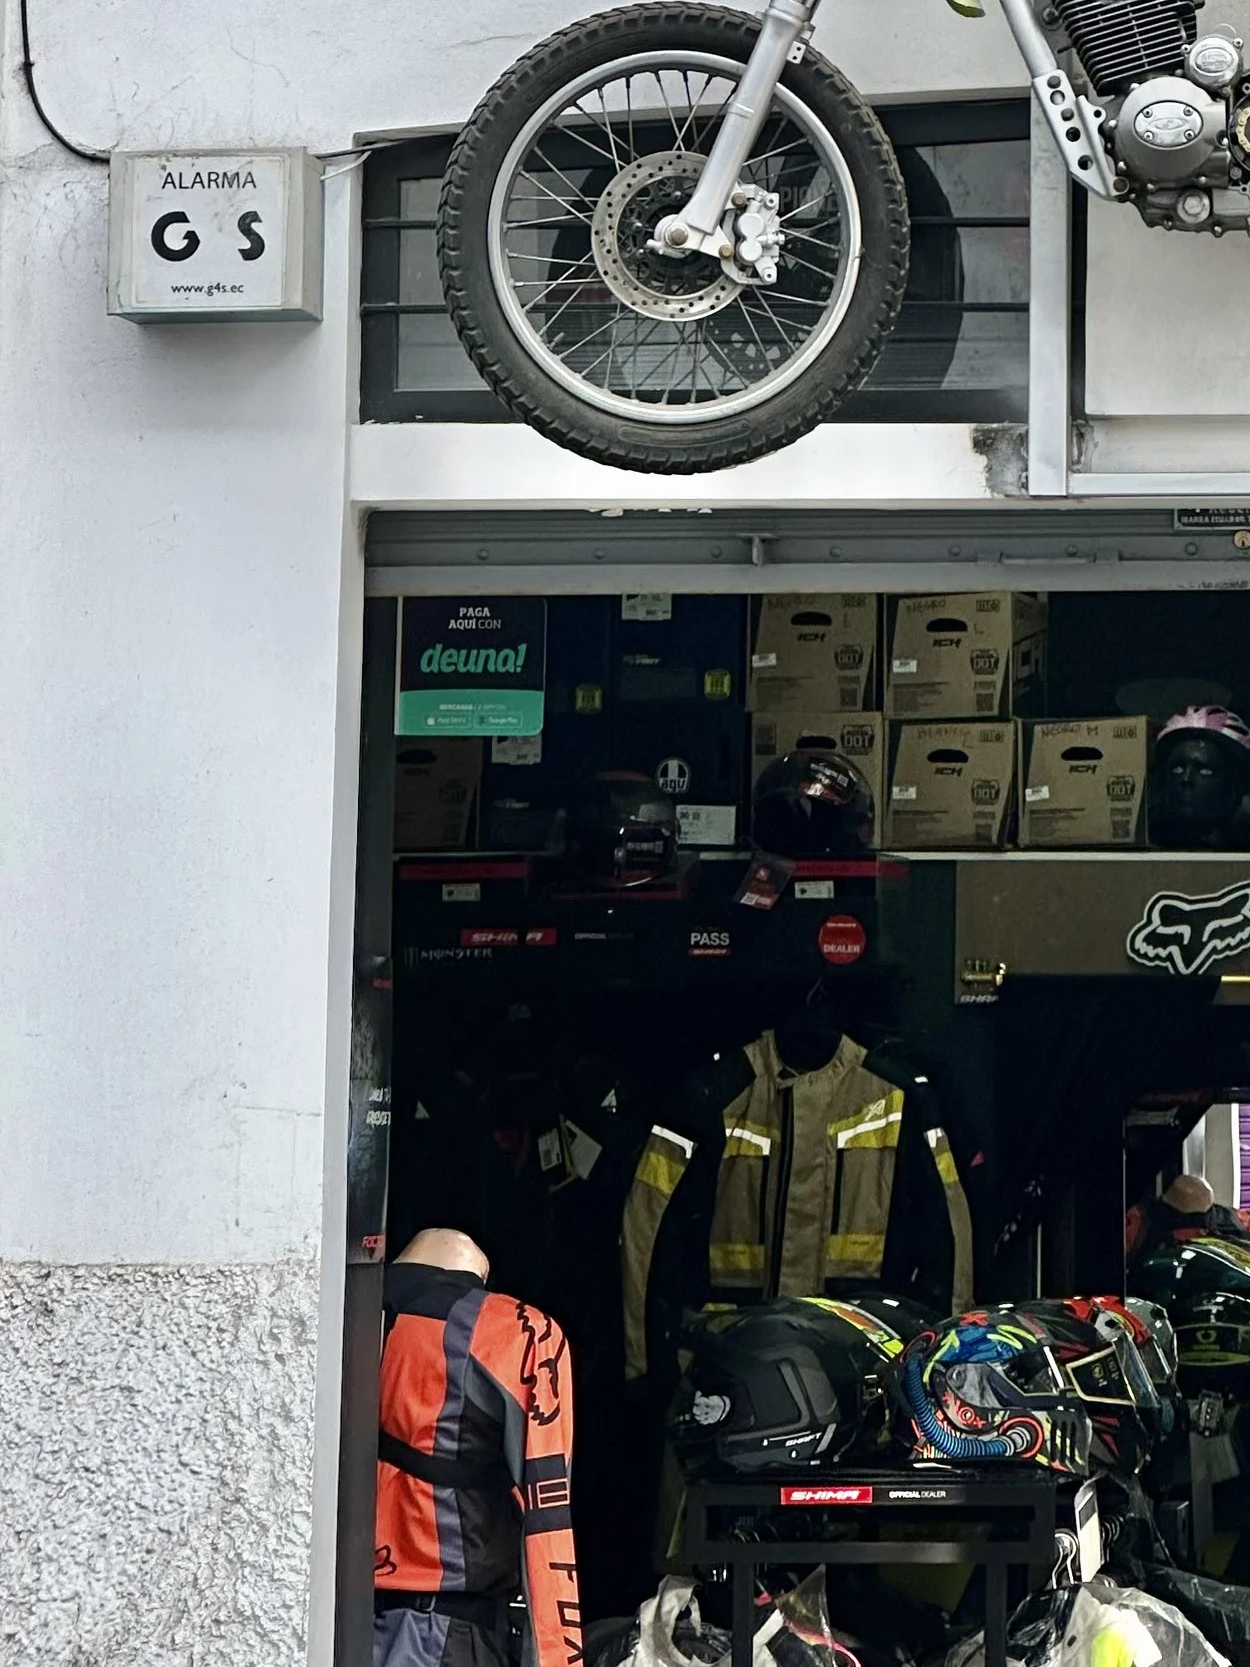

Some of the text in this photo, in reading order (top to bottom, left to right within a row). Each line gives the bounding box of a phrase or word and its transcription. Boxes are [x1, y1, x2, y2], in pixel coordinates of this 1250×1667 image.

[162, 171, 257, 189] ALARMA
[171, 282, 244, 296] www.g4s.ec
[459, 607, 490, 617] PAGA
[448, 618, 502, 630] AQUÍ CON
[420, 643, 527, 673] deuna!
[690, 932, 730, 945] PASS
[790, 1490, 947, 1501] SHIMA OFFICIAL DEALER
